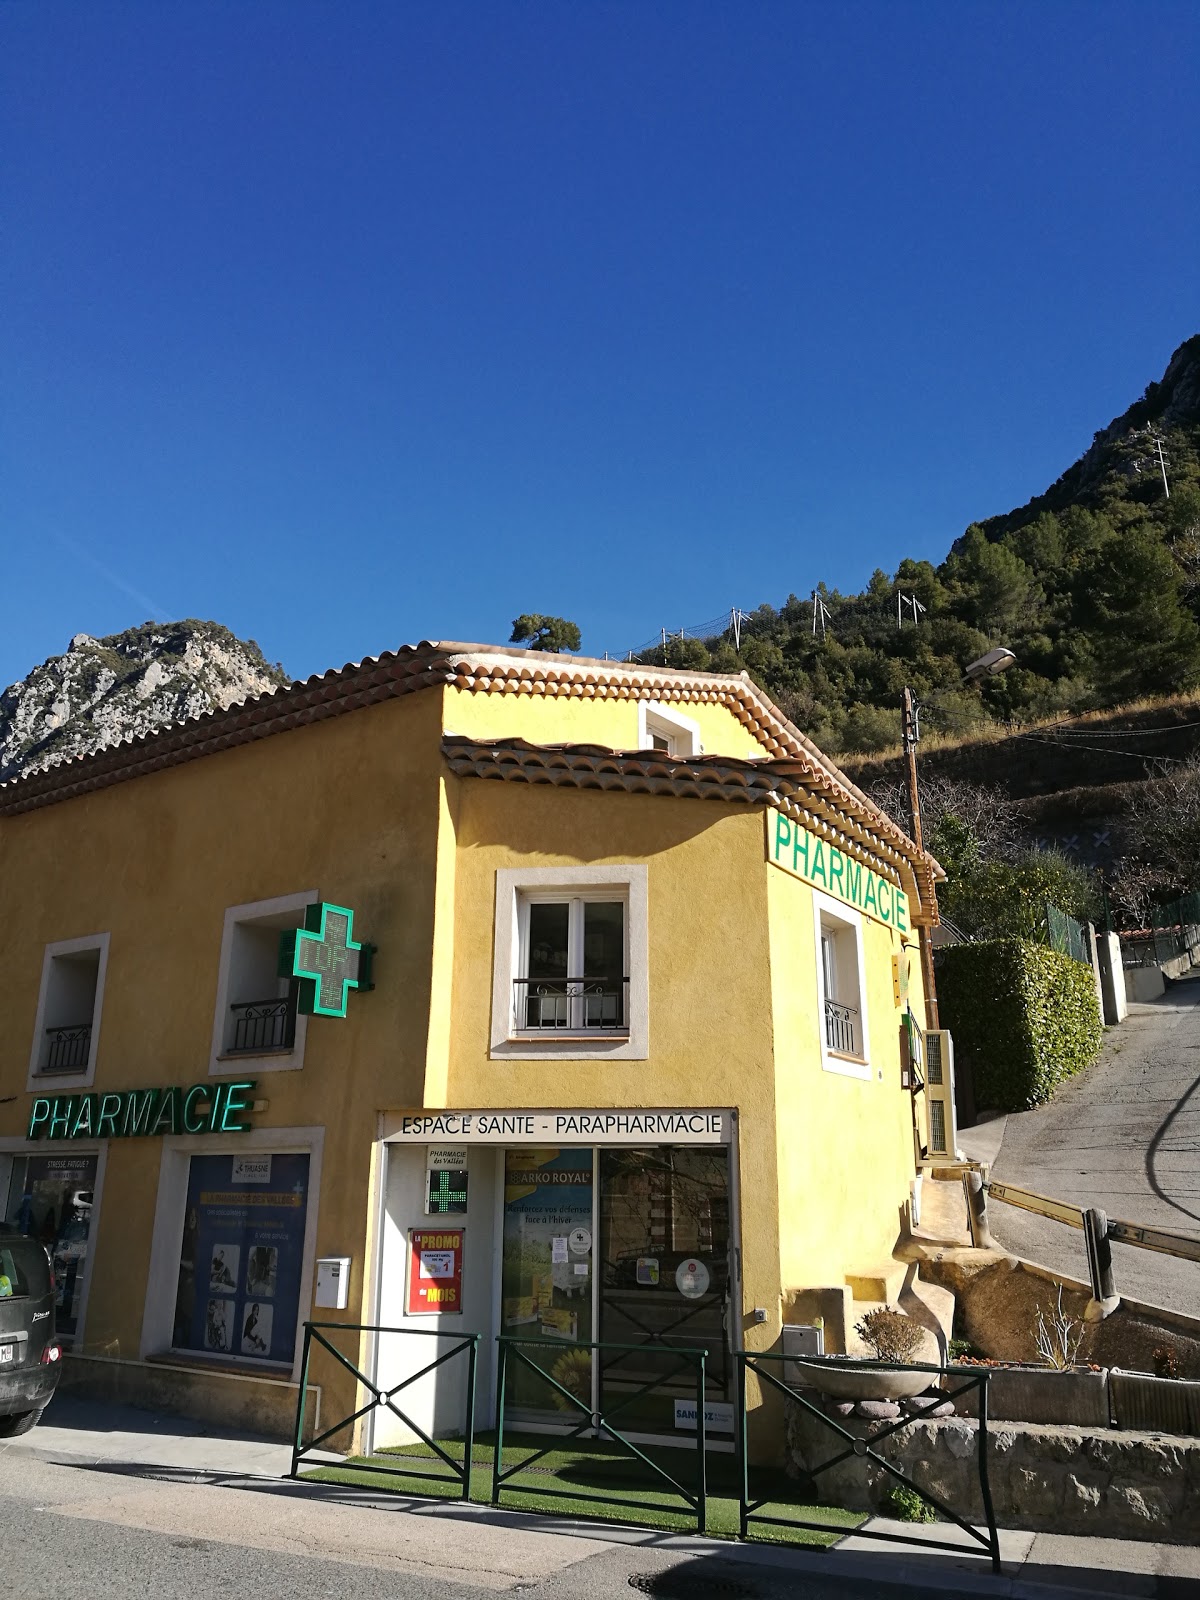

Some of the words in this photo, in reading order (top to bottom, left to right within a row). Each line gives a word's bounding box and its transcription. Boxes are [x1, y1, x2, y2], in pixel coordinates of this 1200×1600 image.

[775, 812, 907, 933] PHARMACIE
[27, 1081, 256, 1140] PHARMACIE
[402, 1115, 471, 1134] ESPACE
[477, 1116, 535, 1134] SANTE
[556, 1115, 721, 1134] PARAPHARMACIE
[429, 1150, 467, 1158] PHARMACIE
[244, 1164, 269, 1173] THUASNE
[520, 1172, 550, 1184] ARKO
[506, 1204, 543, 1213] Renforcez
[560, 1205, 591, 1214] défenses
[525, 1215, 540, 1223] face
[420, 1235, 460, 1249] PROMO
[426, 1288, 456, 1303] MOIS
[676, 1409, 714, 1421] SANZ
